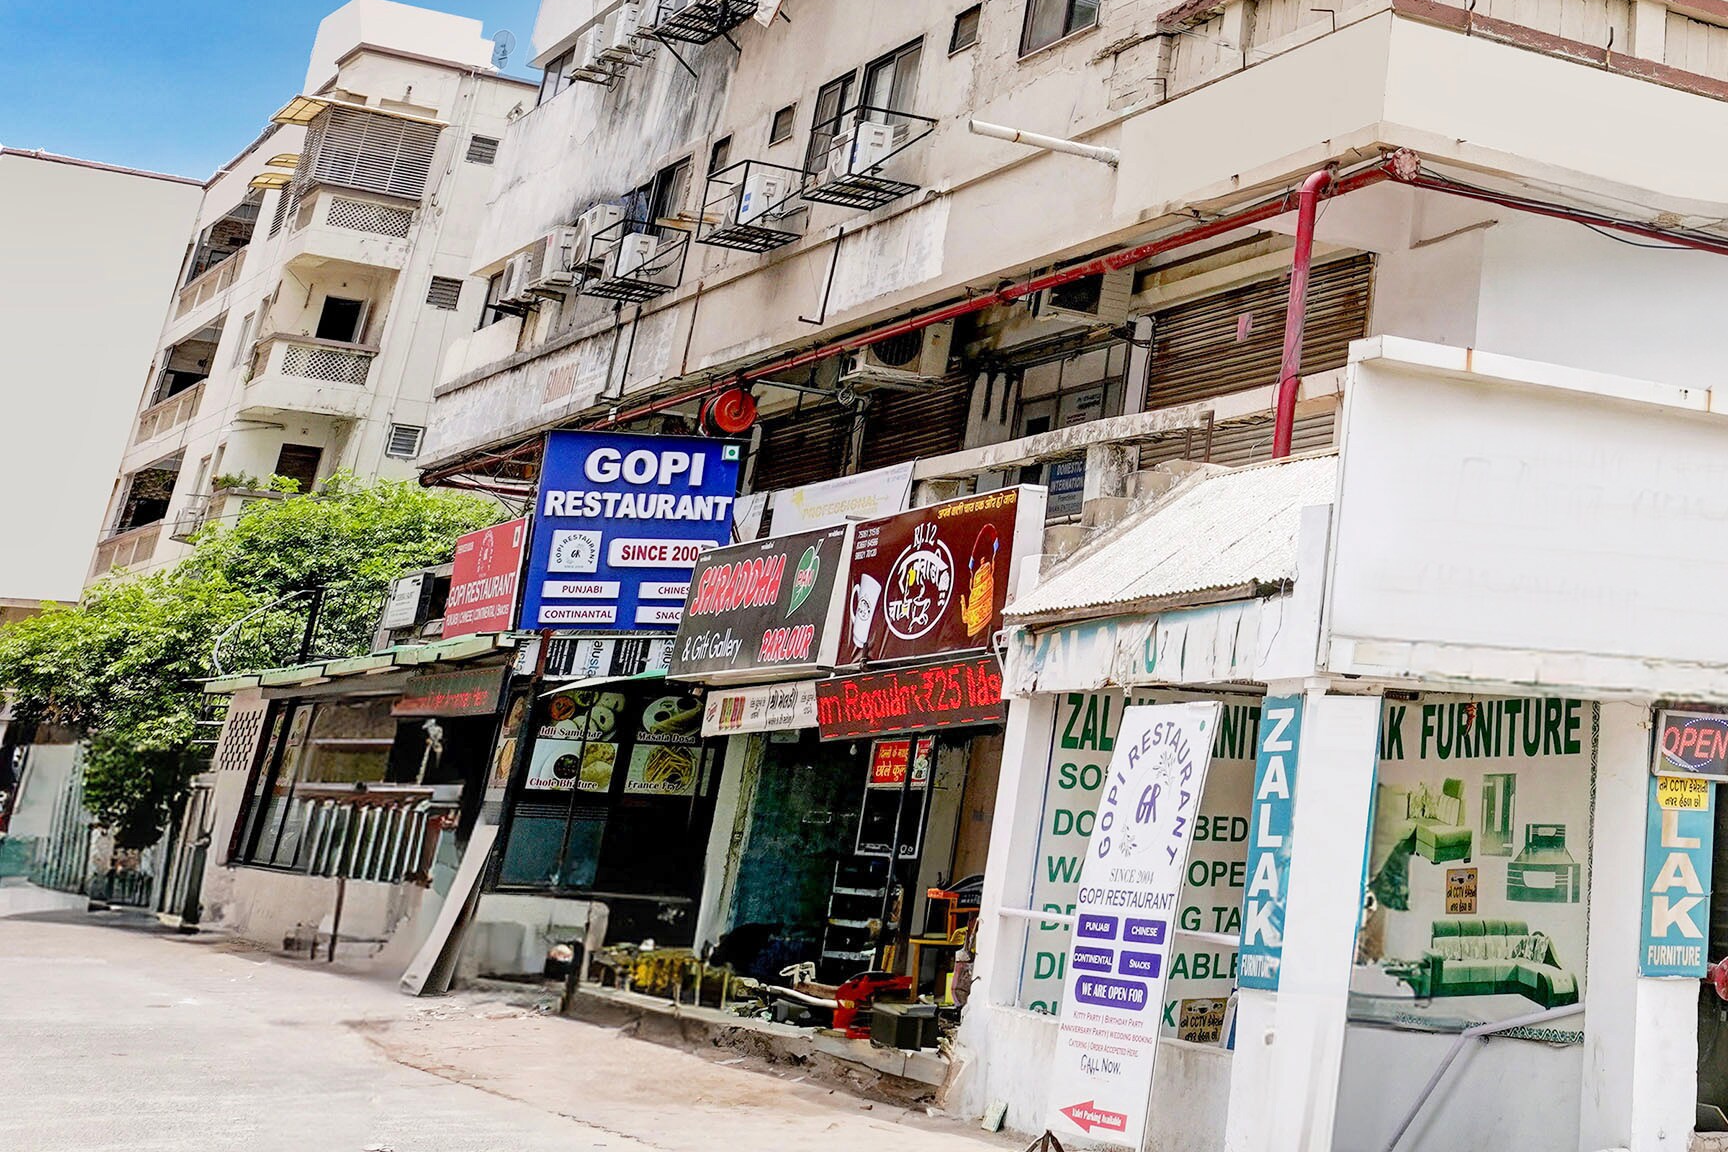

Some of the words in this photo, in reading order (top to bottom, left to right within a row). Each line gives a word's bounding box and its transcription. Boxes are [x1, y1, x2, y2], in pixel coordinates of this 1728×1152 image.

[585, 447, 706, 487] GOPI
[544, 490, 733, 521] RESTAURANT
[621, 545, 667, 562] SINCE
[448, 584, 466, 608] GOPI
[465, 572, 516, 604] RESTAURANT
[562, 585, 603, 595] PUNJABI
[658, 586, 690, 596] CHINES
[690, 553, 787, 617] SHRADDHA
[544, 609, 612, 619] CONTINANTAL
[656, 611, 682, 621] SNAC
[681, 636, 692, 662] &
[692, 630, 710, 660] Gift
[708, 628, 743, 664] Gallery
[757, 623, 815, 664] PARLOUR
[539, 726, 556, 736] Idli
[637, 731, 670, 743] Masala
[672, 734, 696, 744] Dosa
[1421, 699, 1581, 760] FURNITURE
[529, 777, 556, 787] Chole
[558, 779, 599, 790] Bhture
[627, 780, 660, 790] France
[1098, 771, 1126, 860] GOPI
[1127, 720, 1194, 866] RESTAURANT
[1670, 779, 1688, 792] CCTV
[1109, 868, 1135, 884] SINCE
[1650, 810, 1708, 940] LAK
[1079, 887, 1104, 907] GOPI
[1105, 888, 1175, 912] RESTAURANT
[1085, 921, 1110, 933] PUNJABI
[1131, 925, 1158, 937] CHINESE
[1073, 952, 1113, 966] CONTINENTAL
[1647, 945, 1701, 967] FURNITURE
[1081, 981, 1092, 997] WE
[1093, 983, 1107, 998] ARE
[1108, 985, 1128, 1002] OPEN
[1128, 988, 1144, 1004] FOR
